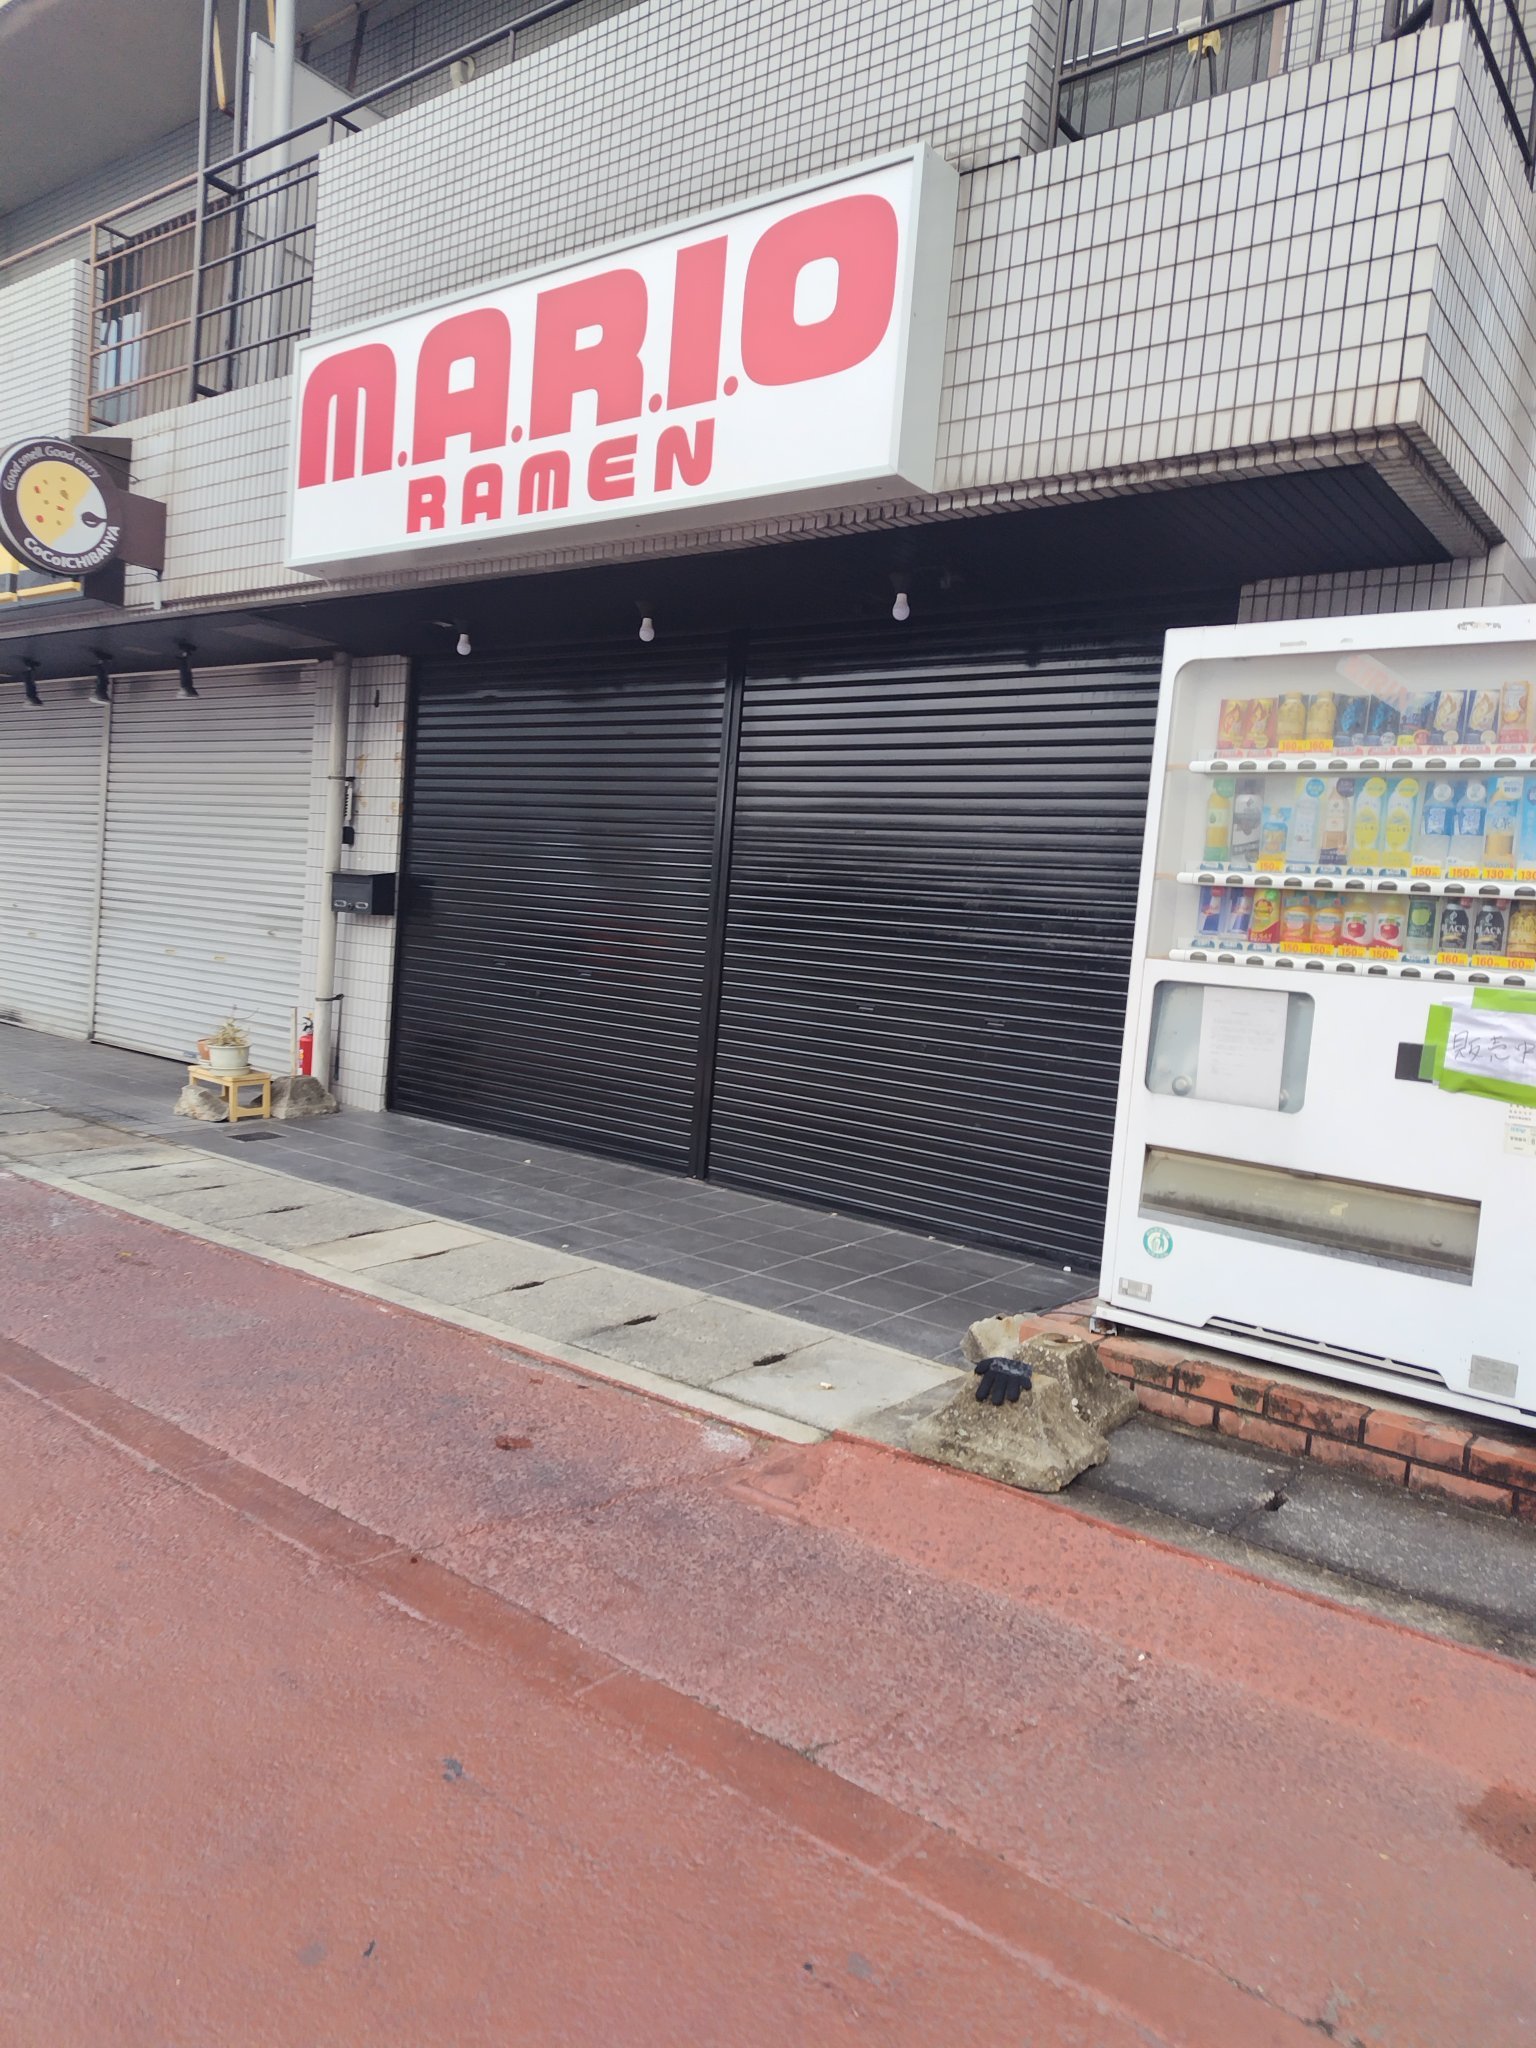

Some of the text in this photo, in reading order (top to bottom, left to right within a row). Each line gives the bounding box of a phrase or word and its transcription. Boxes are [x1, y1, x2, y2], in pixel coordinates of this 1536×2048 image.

[3, 461, 22, 491] Good
[44, 446, 75, 461] Good
[75, 457, 101, 479] curry
[406, 417, 715, 534] RAMEN
